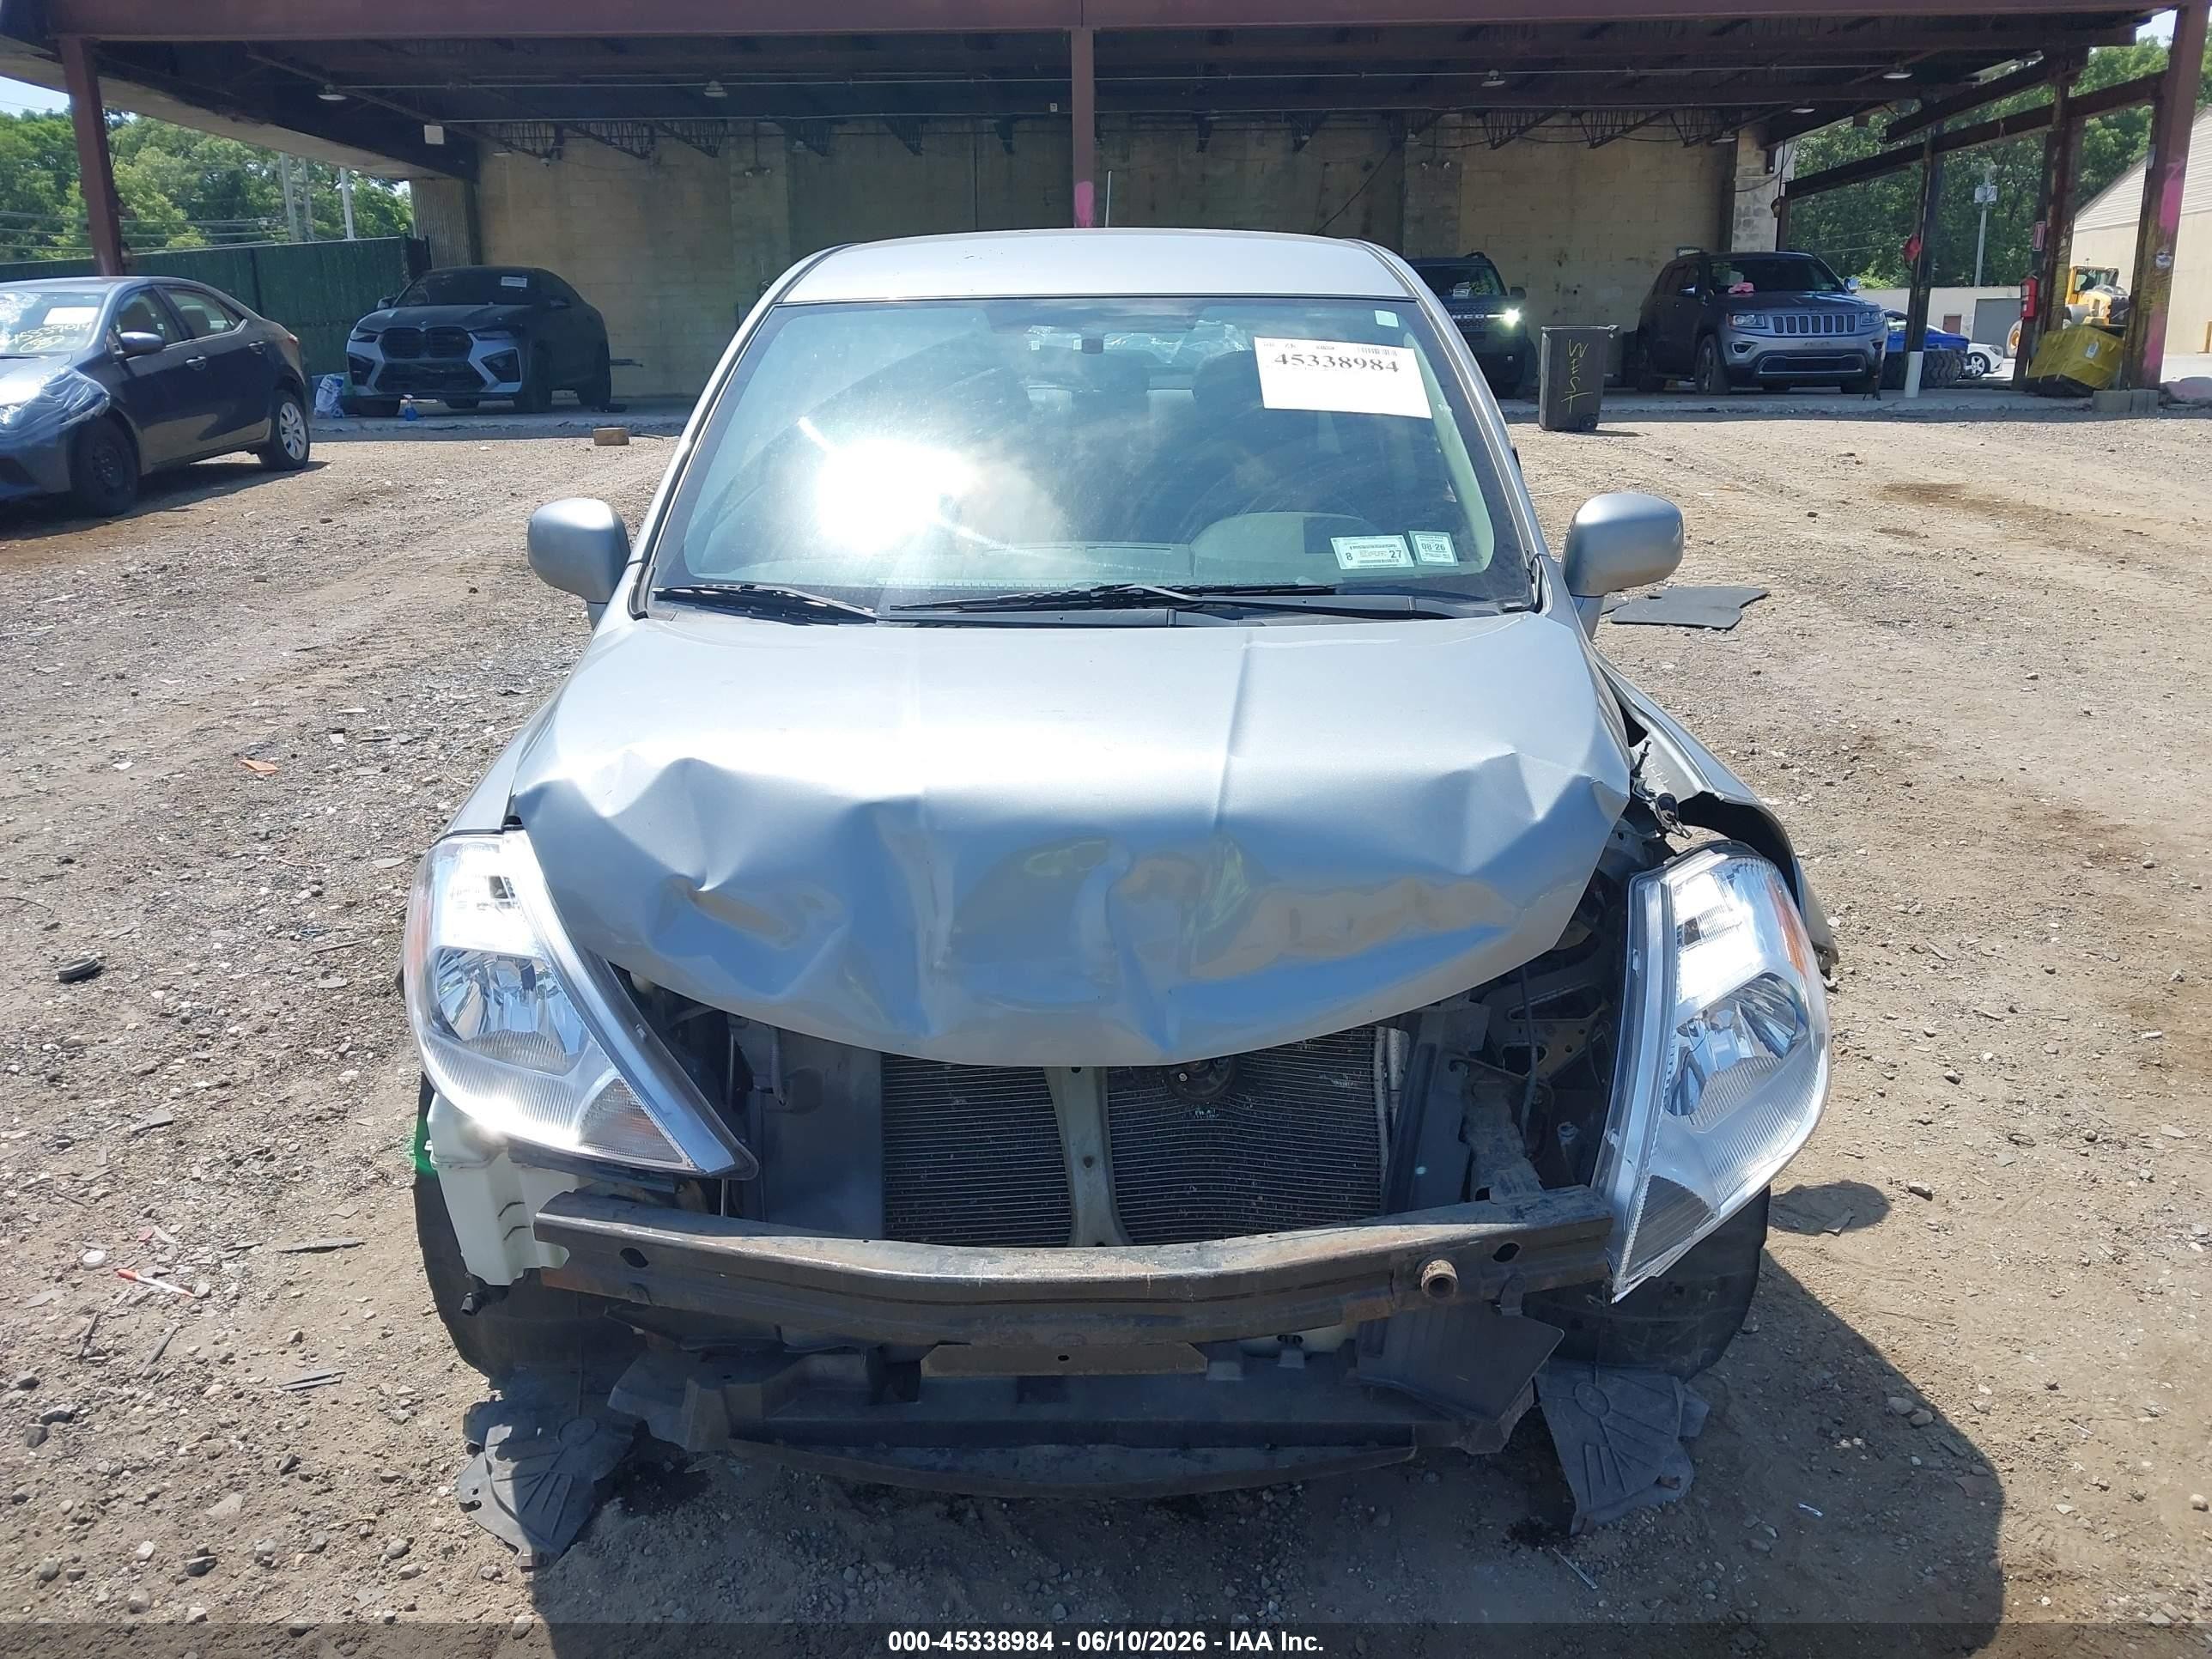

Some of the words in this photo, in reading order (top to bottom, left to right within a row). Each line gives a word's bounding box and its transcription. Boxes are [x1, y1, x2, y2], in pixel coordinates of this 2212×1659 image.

[1274, 353, 1400, 374] 45338984
[1560, 338, 1595, 413] WEST
[1345, 552, 1353, 561] 8
[1389, 550, 1402, 559] 27
